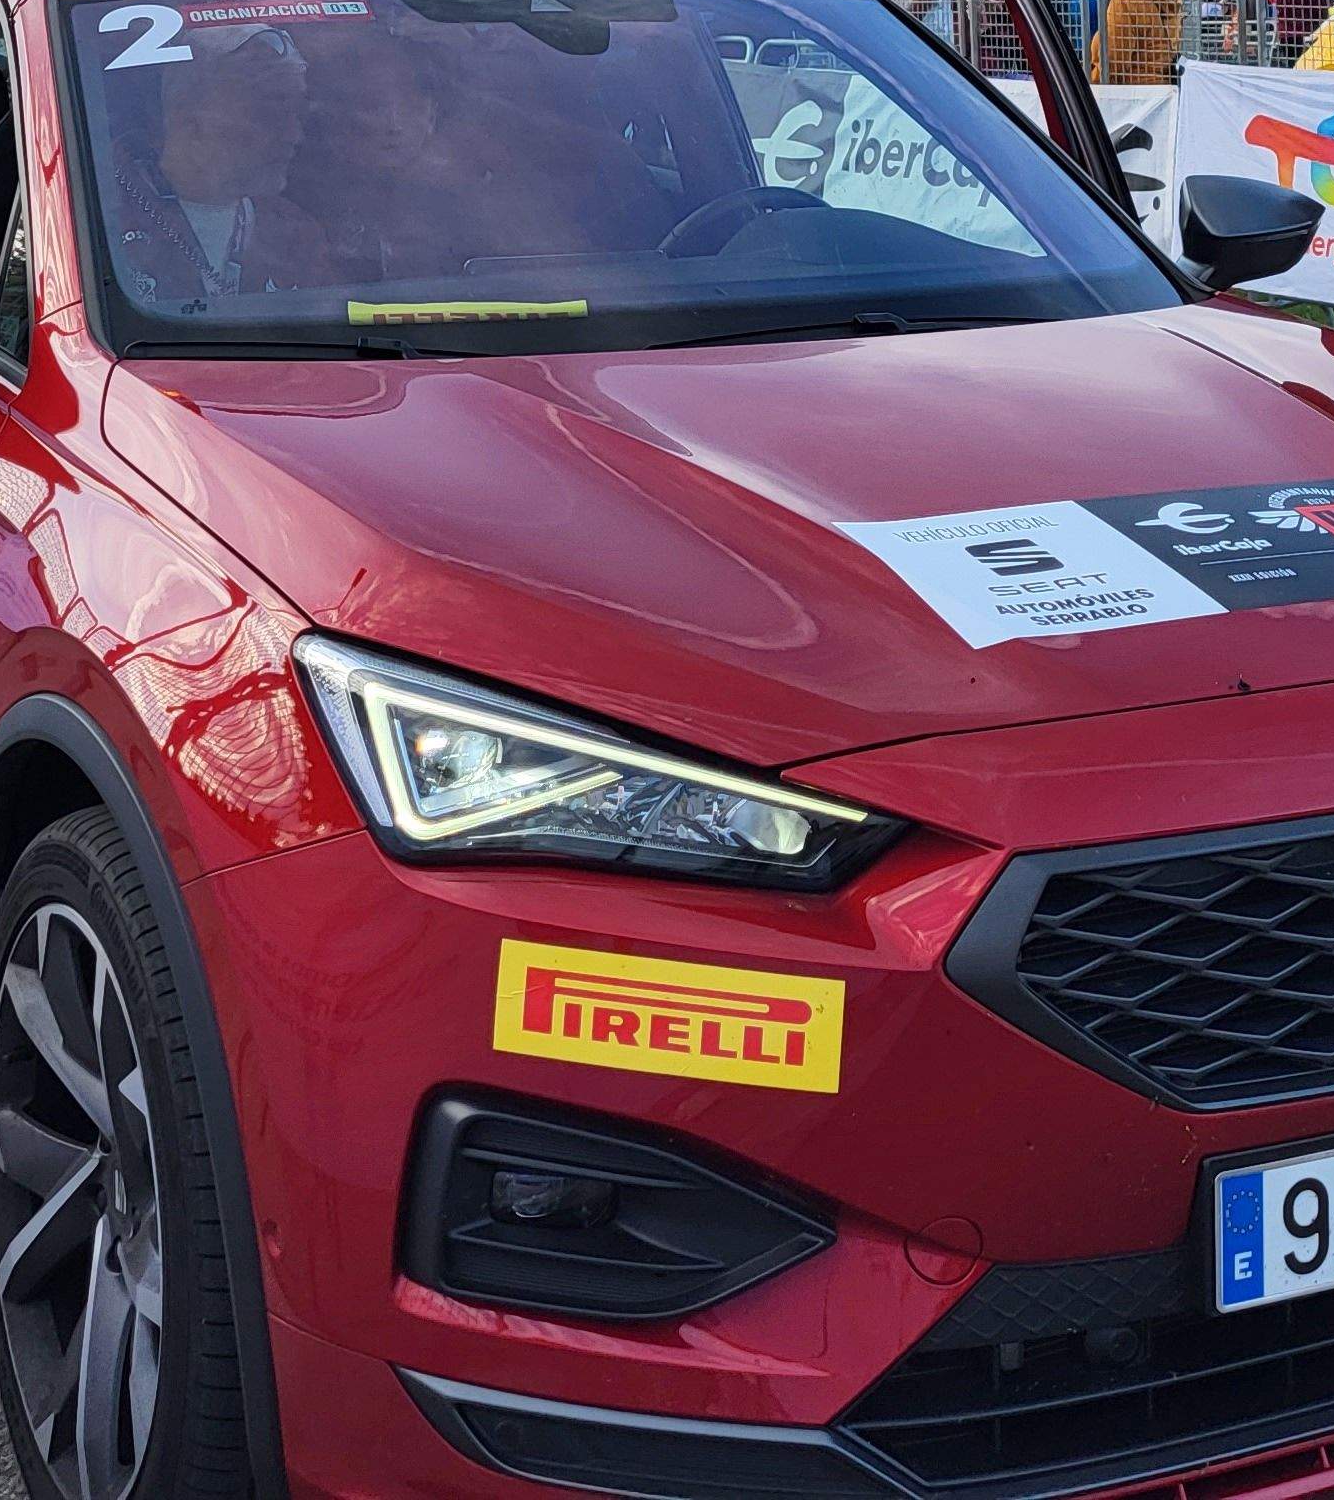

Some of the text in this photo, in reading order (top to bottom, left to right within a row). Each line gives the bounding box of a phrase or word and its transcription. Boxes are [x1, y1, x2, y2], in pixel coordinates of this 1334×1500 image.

[189, 2, 362, 23] ORGANIZACIÓN 013
[98, 4, 194, 71] 2
[893, 515, 1060, 543] VEHÍCULO OFICIAL
[1173, 536, 1273, 556] iberCaja
[988, 573, 1108, 597] SEAT
[995, 588, 1155, 616] AUTOMÓVILES
[1030, 603, 1148, 627] SERRABLO
[522, 966, 812, 1066] PIRELLI
[1233, 1250, 1253, 1280] E
